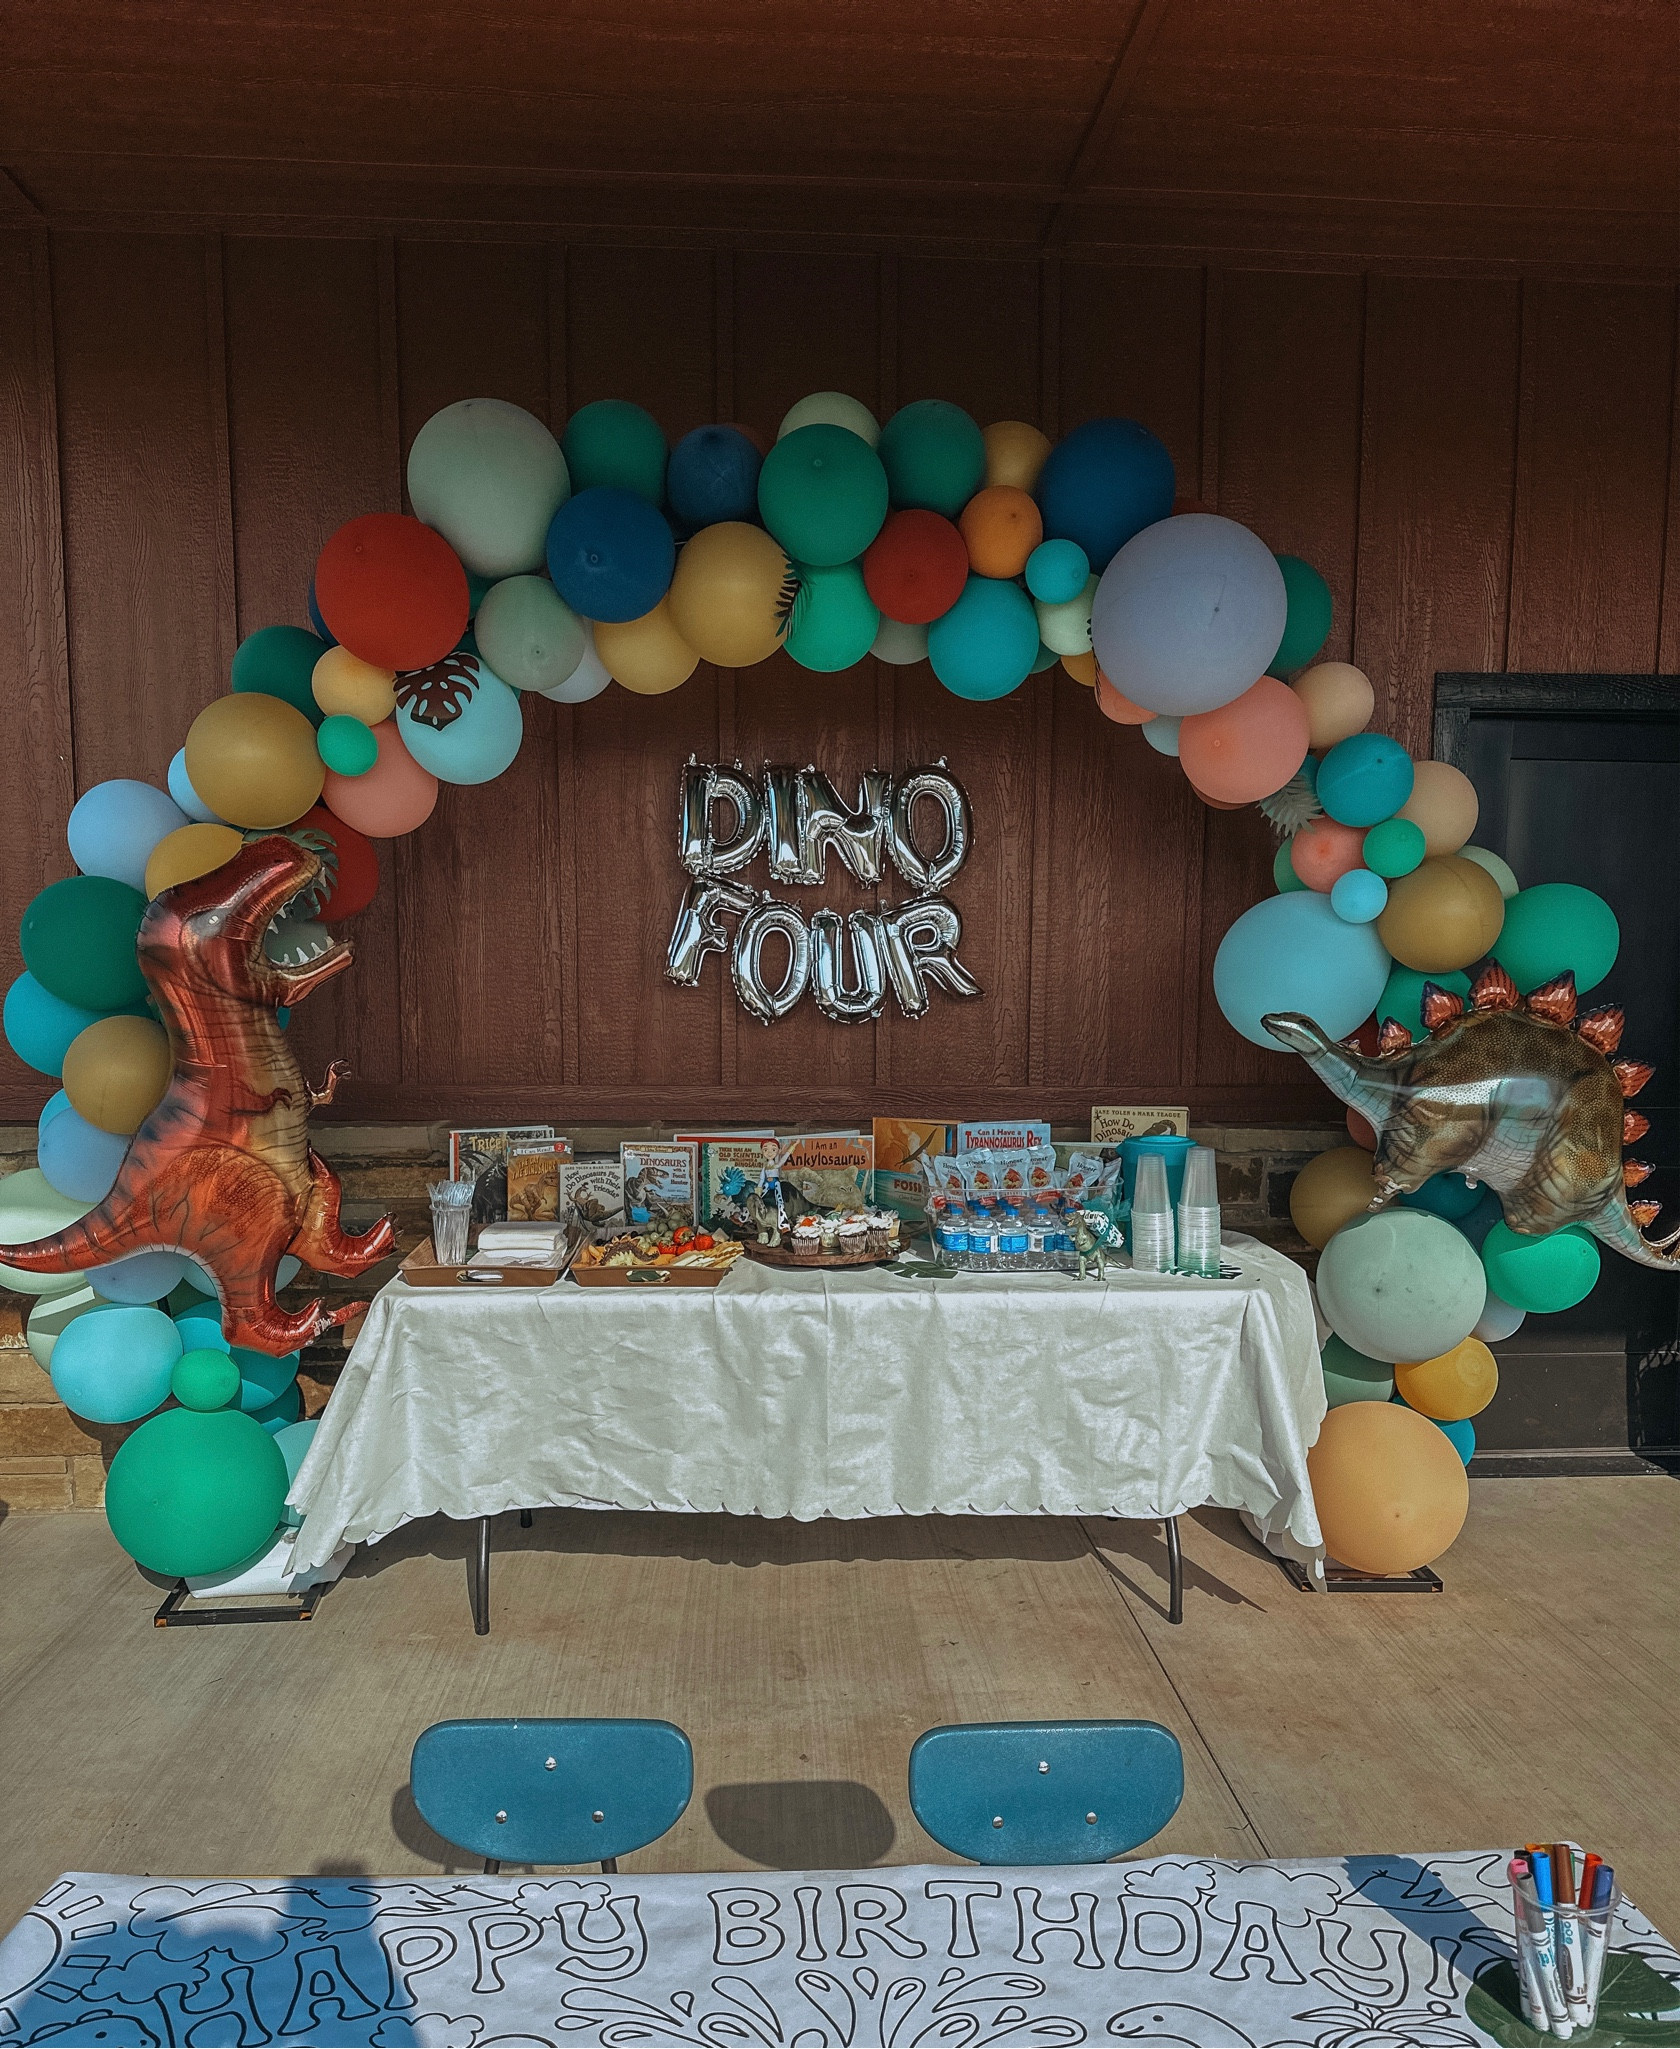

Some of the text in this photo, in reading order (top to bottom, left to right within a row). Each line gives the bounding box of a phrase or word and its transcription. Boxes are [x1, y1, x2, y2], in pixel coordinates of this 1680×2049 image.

[678, 753, 976, 893] DINO
[664, 876, 985, 1026] FOUR
[1100, 1117, 1135, 1131] How Do
[811, 1141, 838, 1150] I Am an
[965, 1130, 1025, 1149] TYRANNOSAURUS
[640, 1158, 687, 1168] DINOSAURS
[784, 1151, 866, 1168] Ankylosaurus
[565, 1182, 576, 1191] Do
[574, 1171, 607, 1184] Dinosaurs
[590, 1177, 621, 1190] with Their
[153, 1880, 1461, 2049] HAPPY BIRTHDAY!
